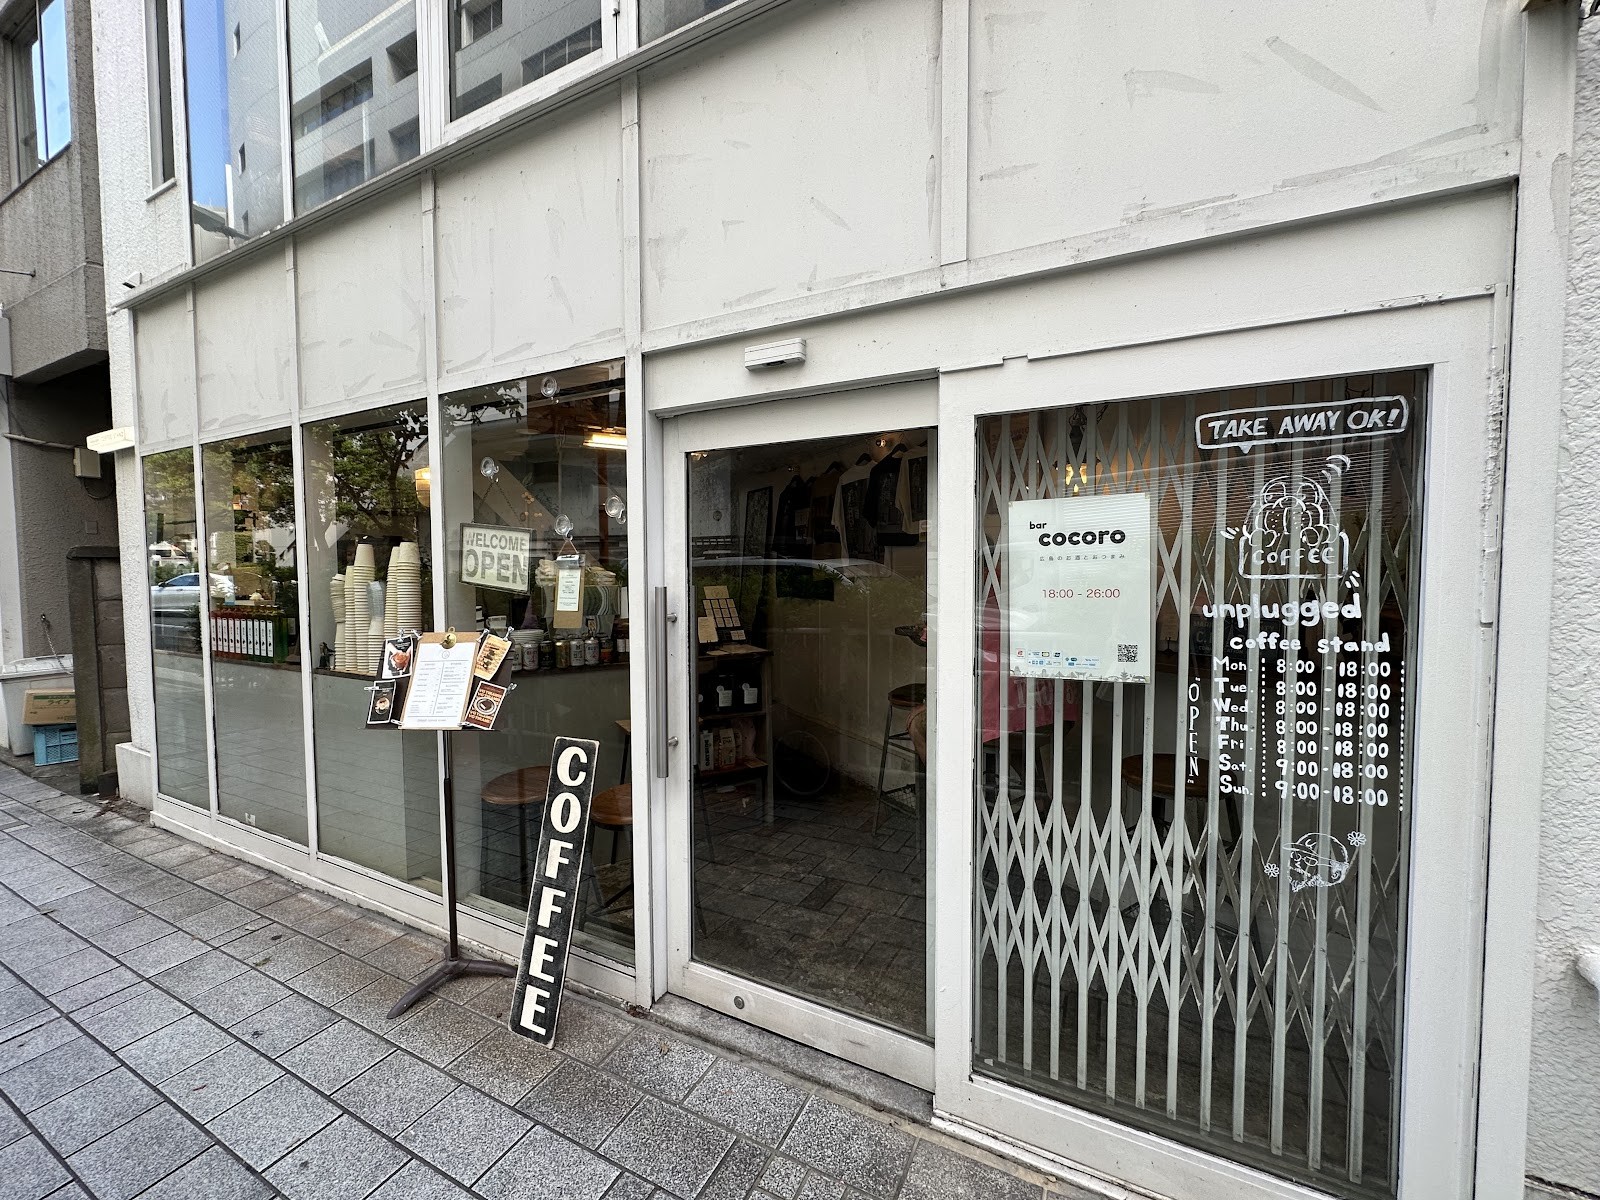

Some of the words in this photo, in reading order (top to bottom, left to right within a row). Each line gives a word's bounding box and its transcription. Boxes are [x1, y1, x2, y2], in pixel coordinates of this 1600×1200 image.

[1208, 417, 1268, 439] TAKE
[1278, 410, 1341, 435] AWAY
[1347, 408, 1400, 429] OK!
[1029, 521, 1047, 530] bar
[465, 532, 527, 551] WELCOME
[1038, 529, 1126, 547] cocoro
[464, 548, 527, 585] OPEN
[1042, 588, 1074, 599] 18:00
[1086, 588, 1121, 598] 26:00
[1203, 593, 1362, 627] unplugged
[1230, 631, 1301, 650] coffee
[1317, 632, 1391, 653] stand
[520, 746, 589, 1037] COFFEE
